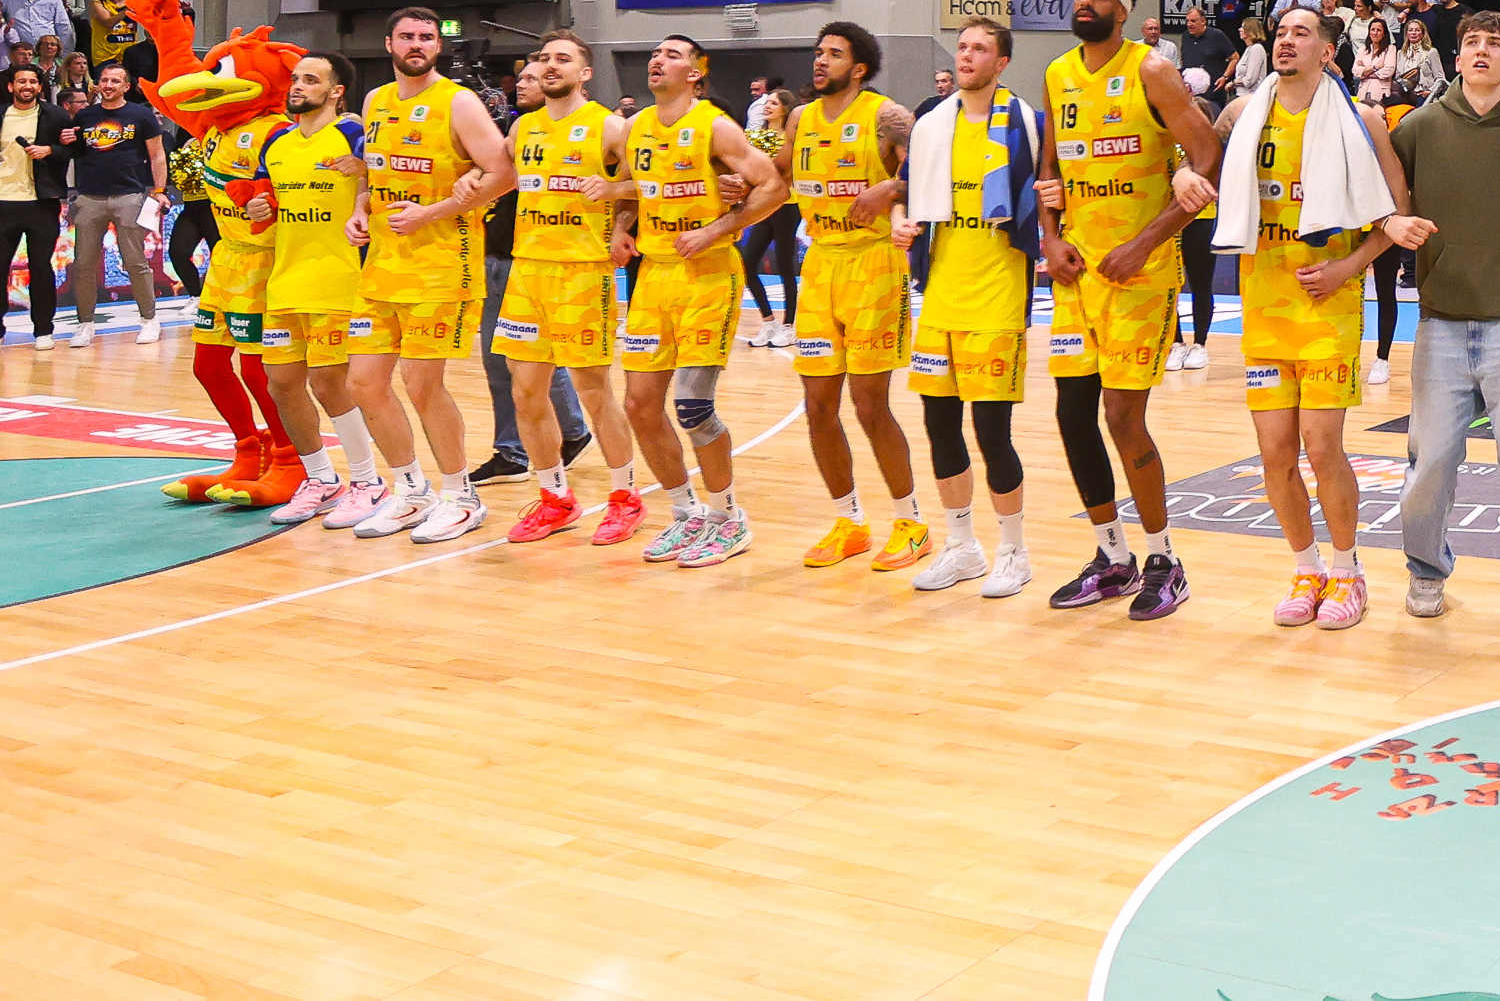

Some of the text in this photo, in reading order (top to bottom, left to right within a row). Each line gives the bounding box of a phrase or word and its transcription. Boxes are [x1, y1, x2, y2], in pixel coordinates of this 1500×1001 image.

[1005, 0, 1017, 16] &
[1061, 103, 1077, 130] 19
[522, 144, 544, 166] 44
[1093, 137, 1139, 156] REWE
[390, 156, 432, 174] REWE
[635, 148, 652, 172] 13
[549, 177, 581, 191] REW
[663, 182, 707, 199] REWE
[1077, 179, 1134, 198] Thalia
[279, 206, 332, 223] Thalia
[530, 210, 582, 226] Thalia
[651, 216, 702, 232] Thalia
